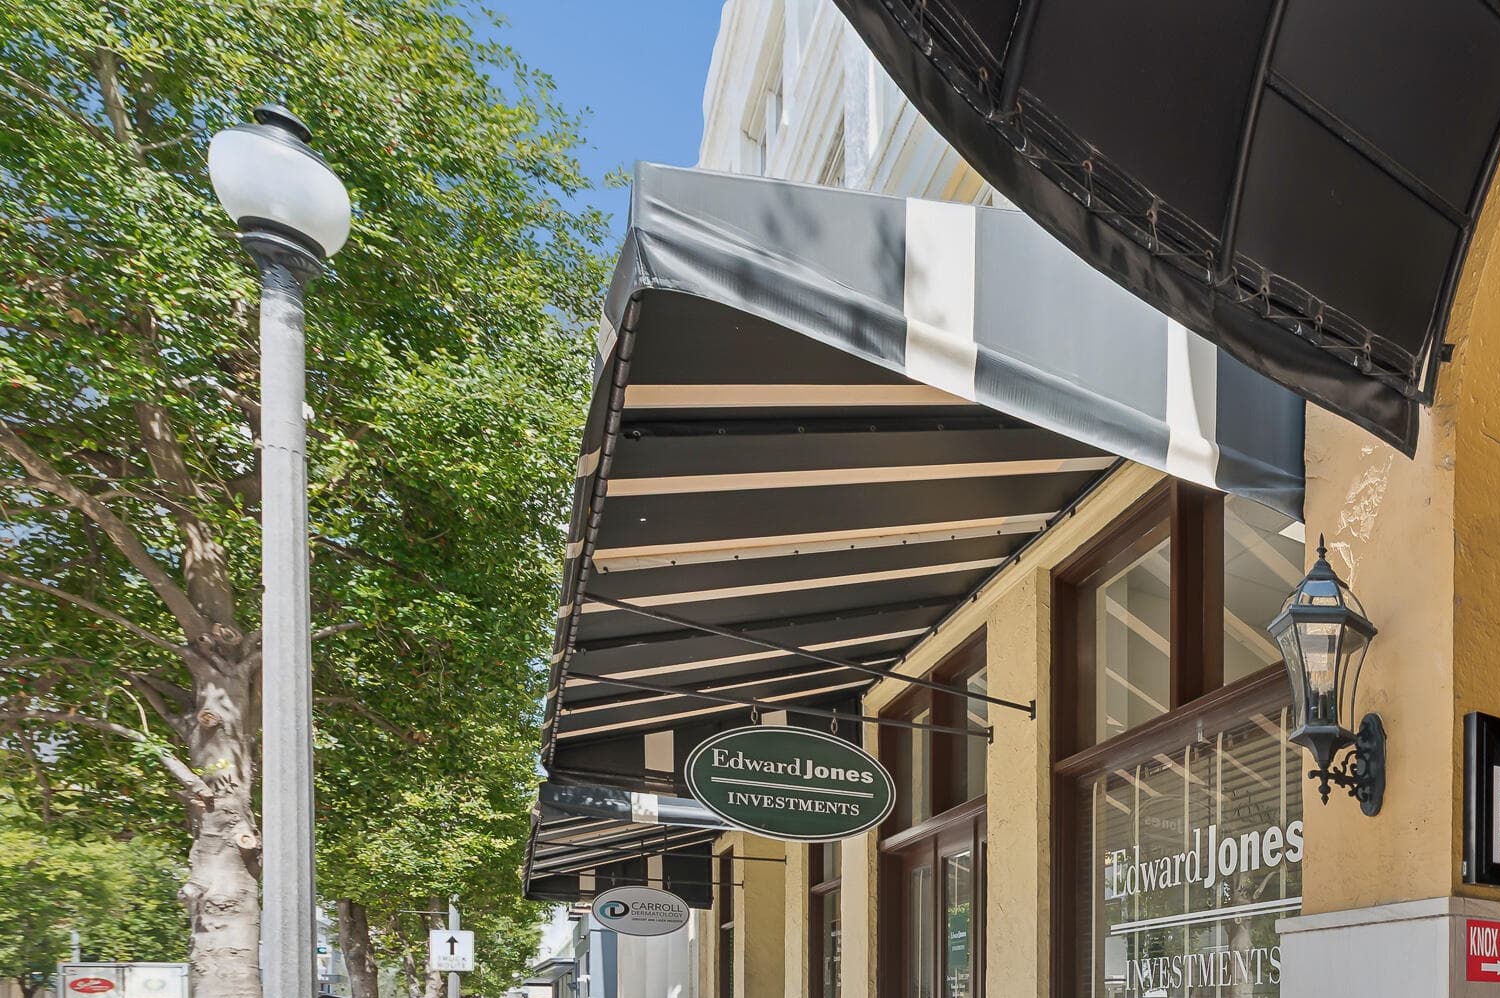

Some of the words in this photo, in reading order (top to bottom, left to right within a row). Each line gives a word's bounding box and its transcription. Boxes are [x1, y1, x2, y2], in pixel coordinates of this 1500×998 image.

[727, 791, 860, 816] INVESTMENTS
[631, 901, 683, 913] CARROLL
[631, 910, 683, 918] DERMATOLOGY
[1470, 926, 1498, 957] KNOX
[1125, 946, 1281, 991] INVESTMENTS
